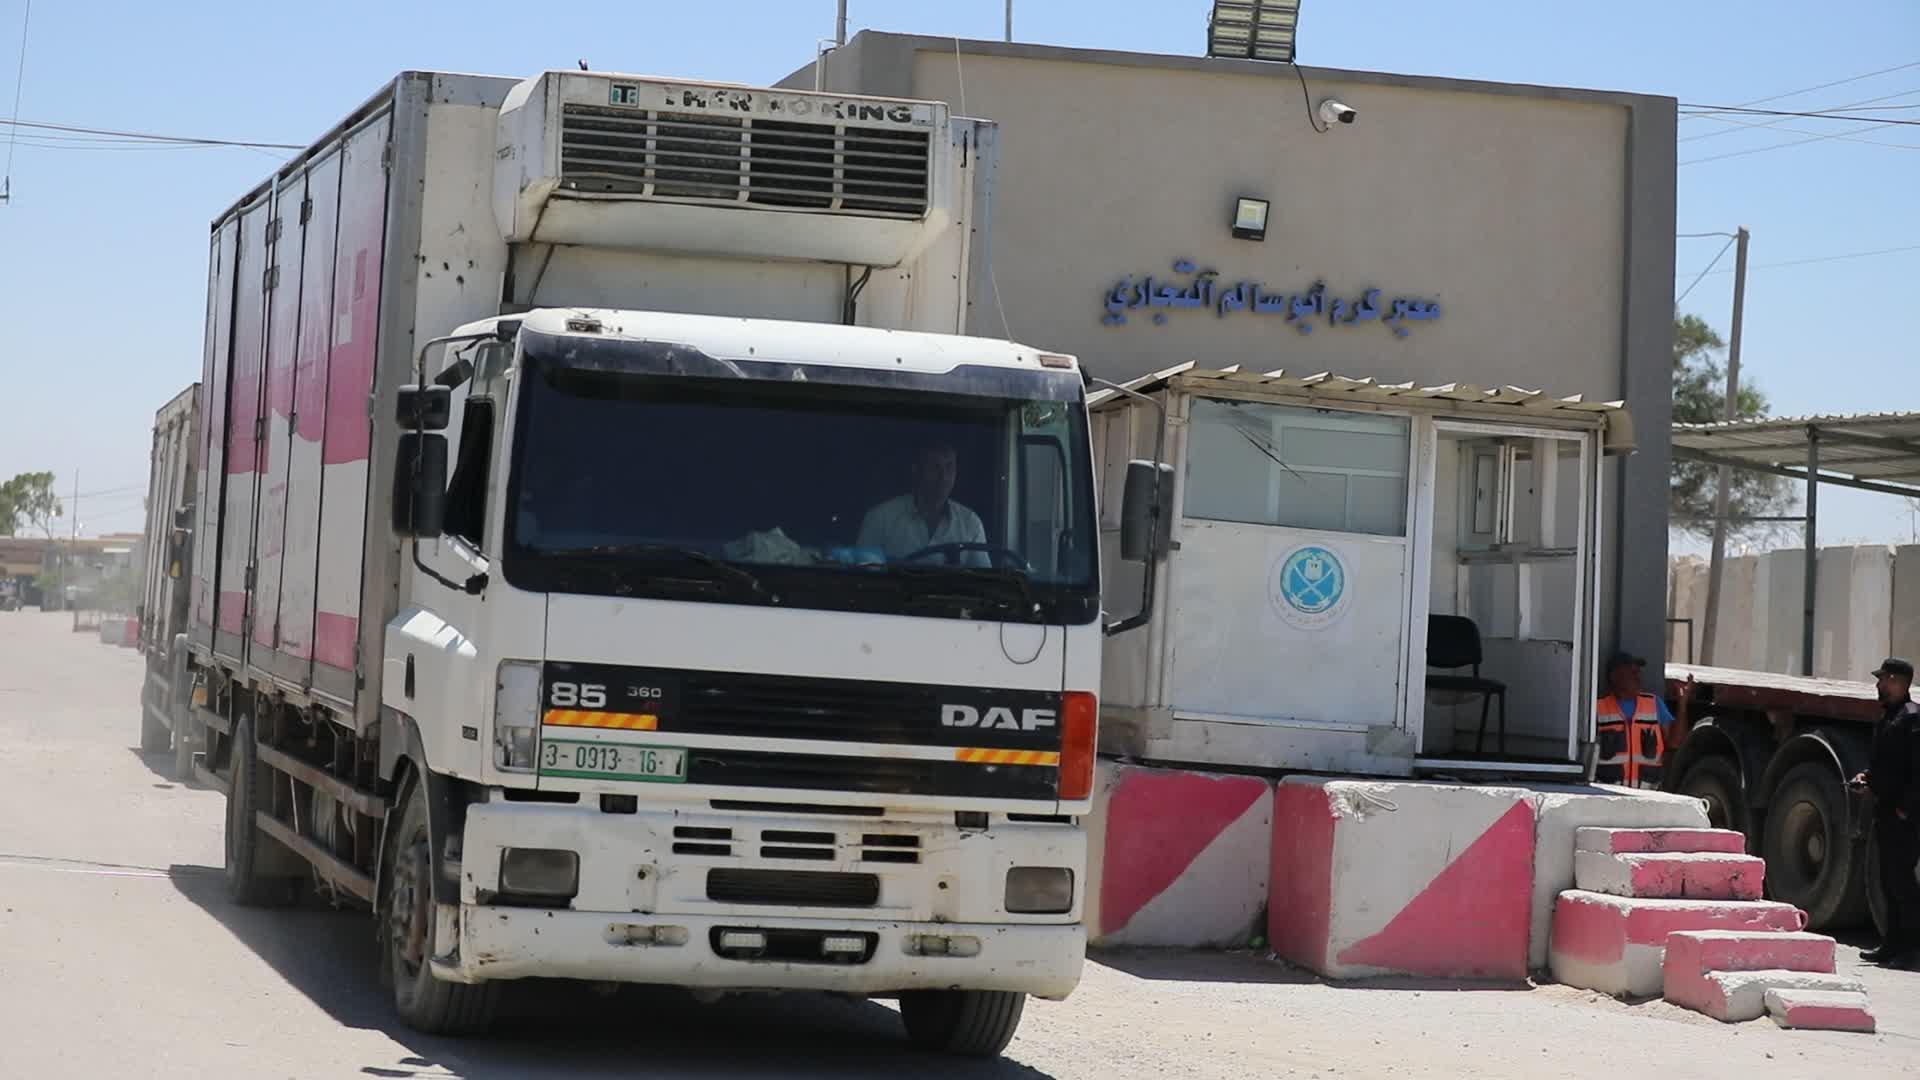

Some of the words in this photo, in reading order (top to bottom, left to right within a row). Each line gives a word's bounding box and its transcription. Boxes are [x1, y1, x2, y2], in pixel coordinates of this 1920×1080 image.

[819, 101, 912, 123] KING
[1218, 282, 1284, 317] سالم
[1331, 288, 1381, 325] كرم
[1382, 298, 1440, 337] معبر
[551, 681, 606, 708] 85
[627, 686, 662, 698] 360
[941, 703, 1056, 731] DAF
